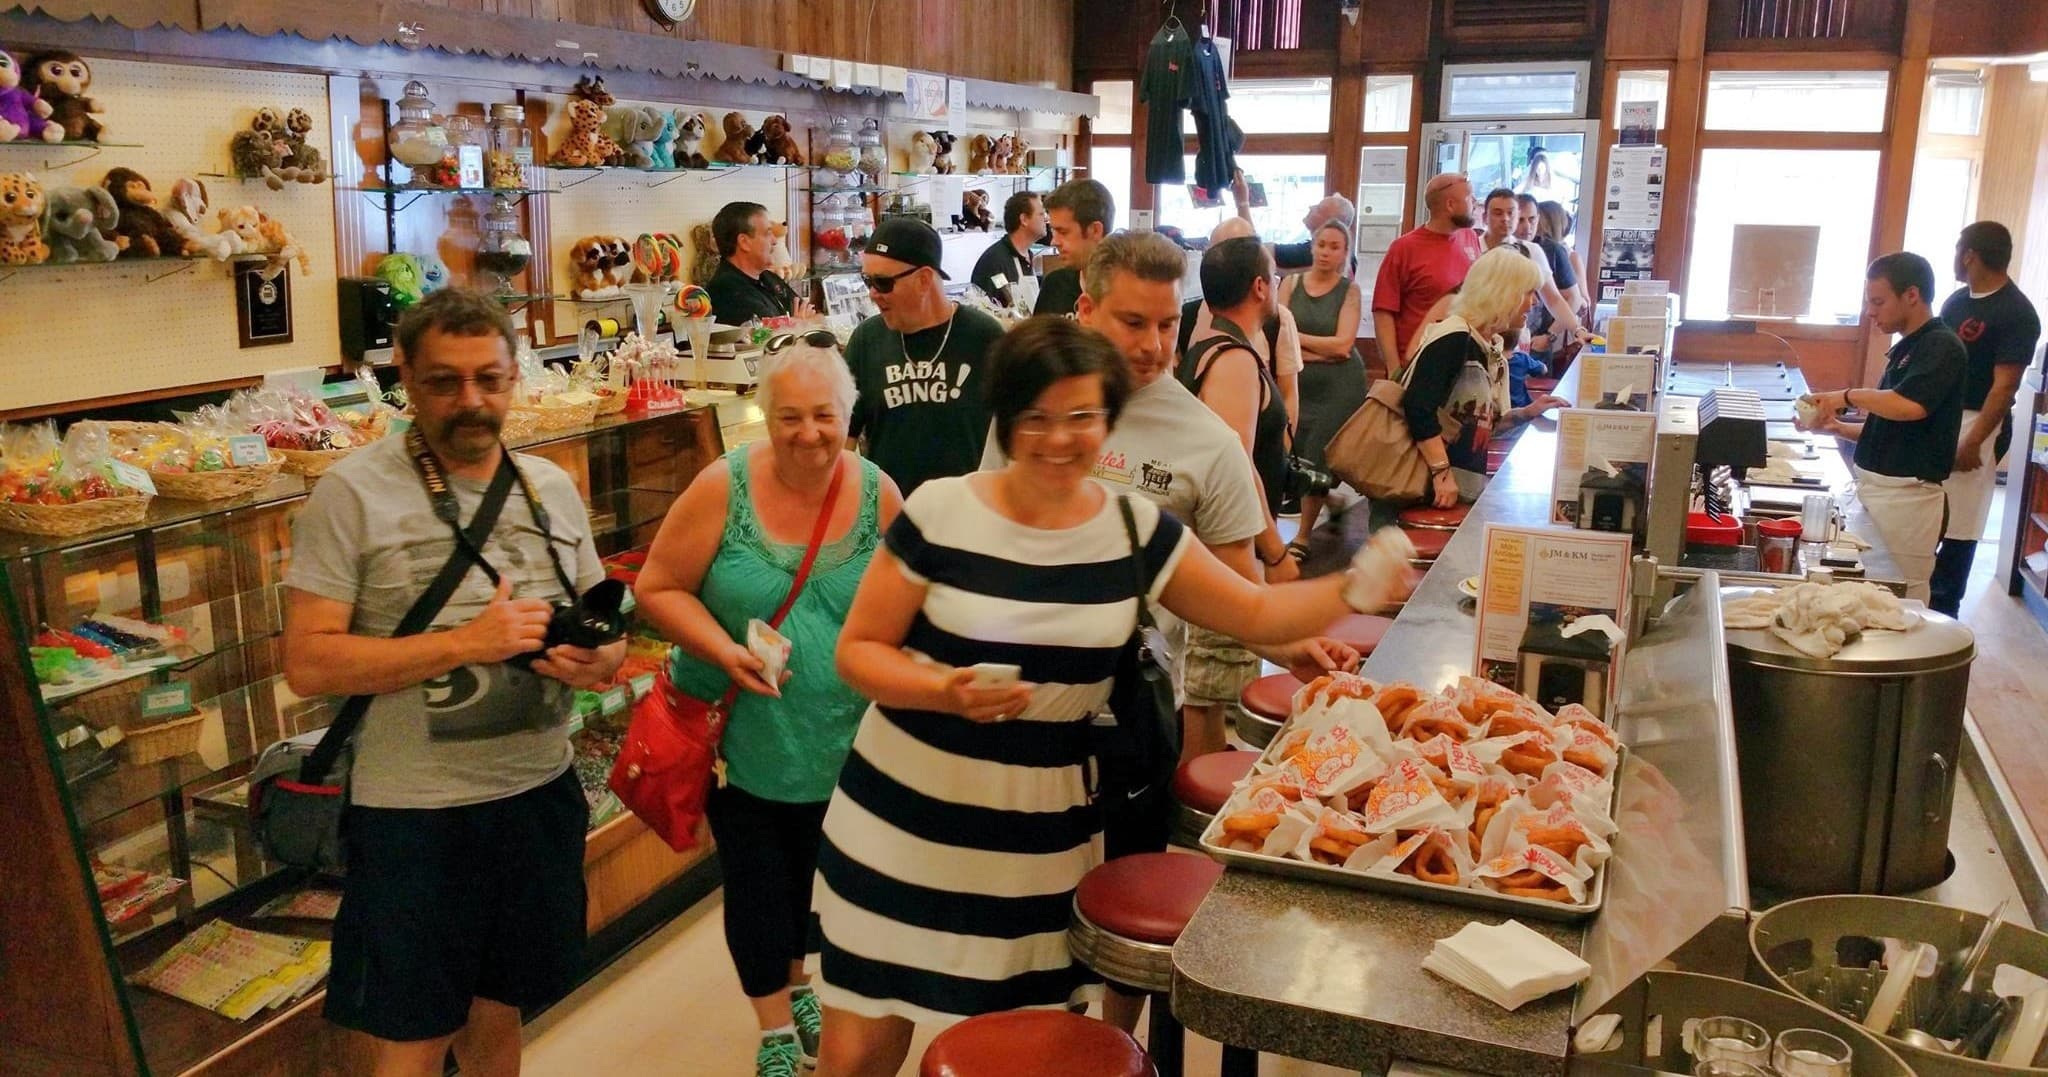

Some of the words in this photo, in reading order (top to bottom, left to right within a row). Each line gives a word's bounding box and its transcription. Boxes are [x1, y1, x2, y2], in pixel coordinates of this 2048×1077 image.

[885, 361, 946, 384] BADA
[1549, 549, 1562, 559] JM
[1571, 551, 1588, 560] KM
